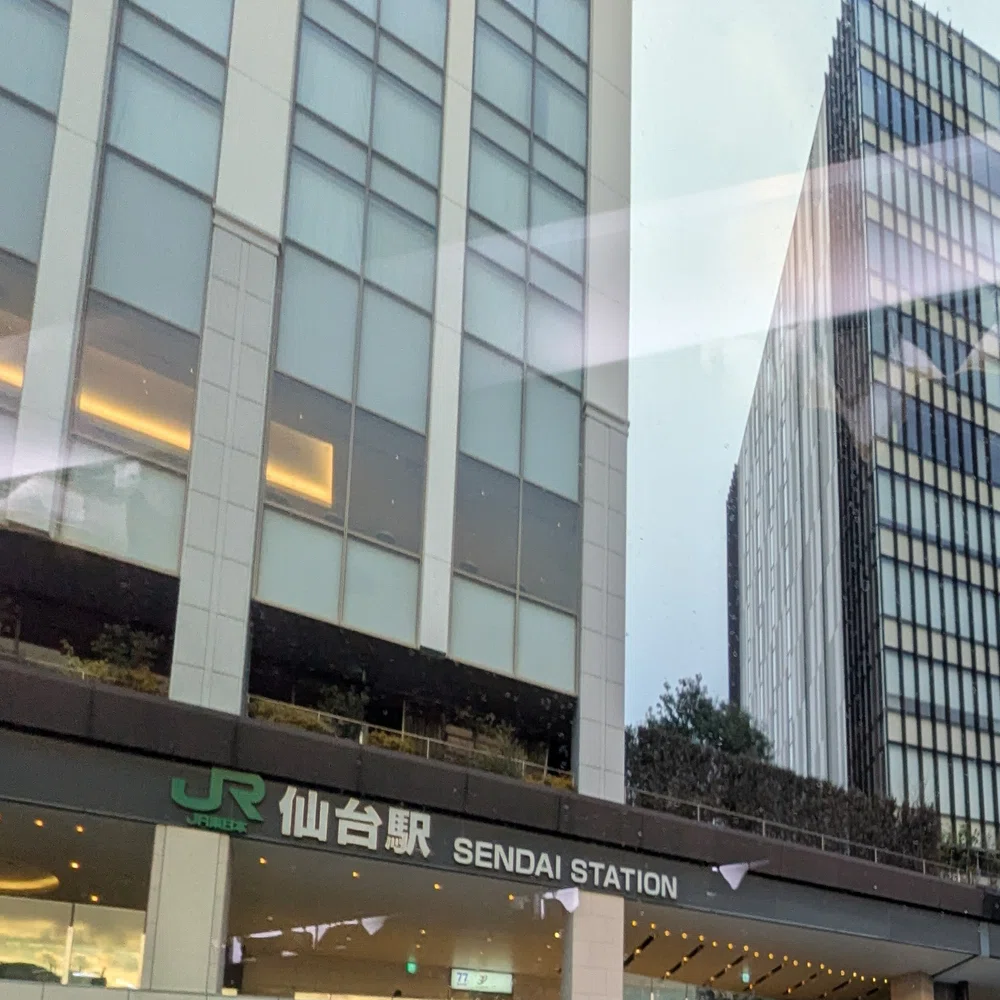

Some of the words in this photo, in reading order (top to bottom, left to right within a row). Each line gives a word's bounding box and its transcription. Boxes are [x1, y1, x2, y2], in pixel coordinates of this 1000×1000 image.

[170, 767, 266, 822] JR
[279, 785, 431, 858] 仙台駅
[453, 837, 561, 880] SENDAI
[570, 858, 678, 899] STATION
